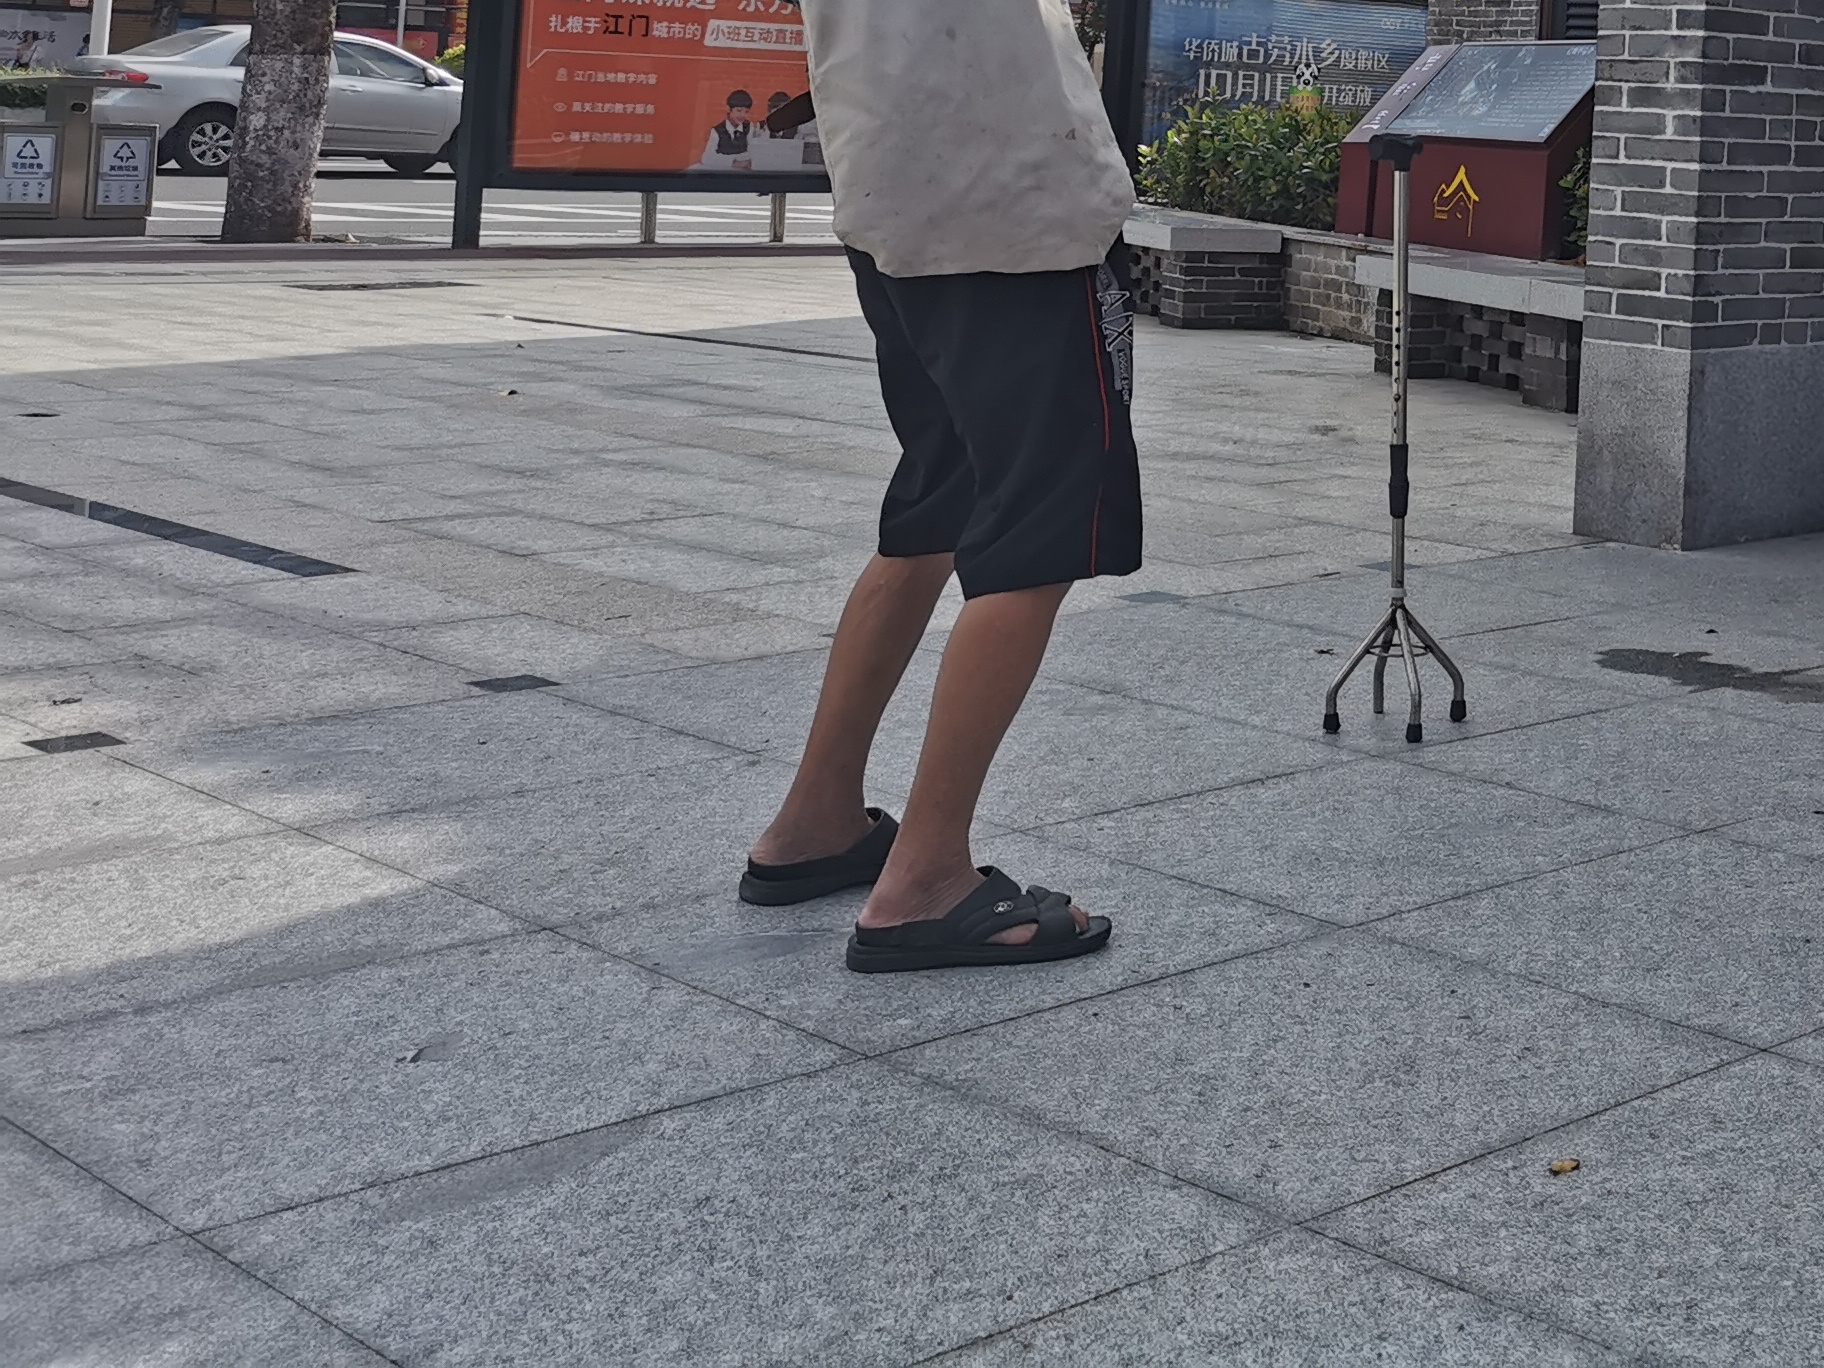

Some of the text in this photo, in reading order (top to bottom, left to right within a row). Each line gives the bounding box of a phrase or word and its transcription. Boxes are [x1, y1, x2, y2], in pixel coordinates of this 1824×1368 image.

[549, 13, 702, 41] 扎根于江门城市的
[1183, 32, 1390, 73] 华侨城古劳水乡度假区
